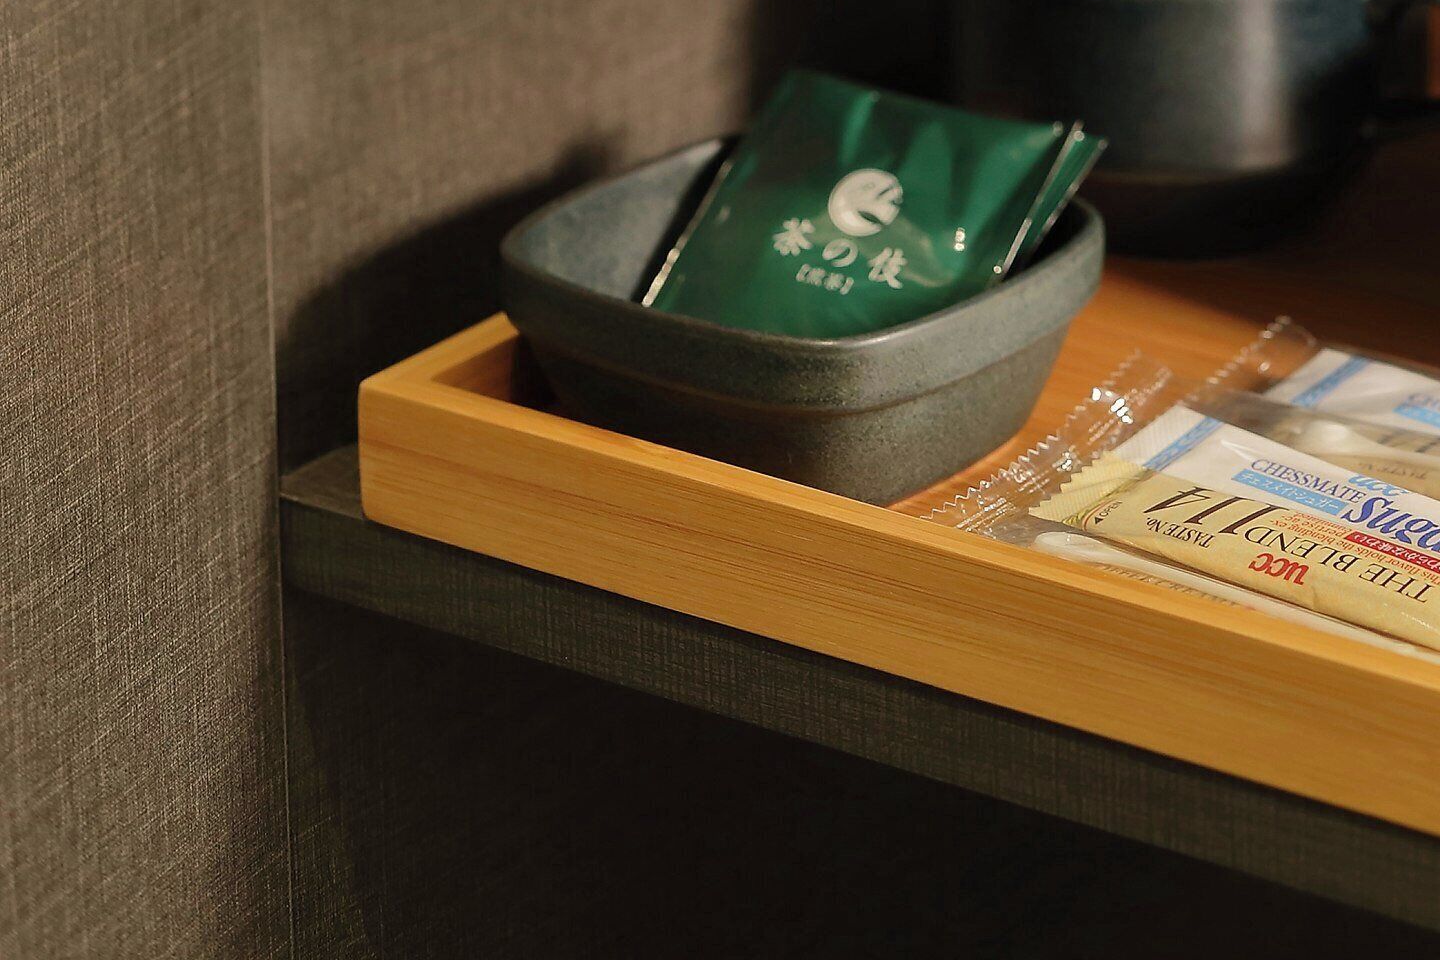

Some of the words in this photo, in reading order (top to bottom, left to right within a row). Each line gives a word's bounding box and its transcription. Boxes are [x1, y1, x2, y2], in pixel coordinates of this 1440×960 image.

[1251, 458, 1367, 503] CHESSMATE
[1142, 486, 1290, 535] 114
[1146, 517, 1168, 533] No.
[1163, 523, 1216, 548] TASTE
[1288, 524, 1336, 545] blending
[1244, 526, 1363, 573] BLEND
[1336, 539, 1356, 551] the
[1355, 545, 1385, 562] holds
[1390, 558, 1420, 576] flavor
[1358, 563, 1437, 603] THE
